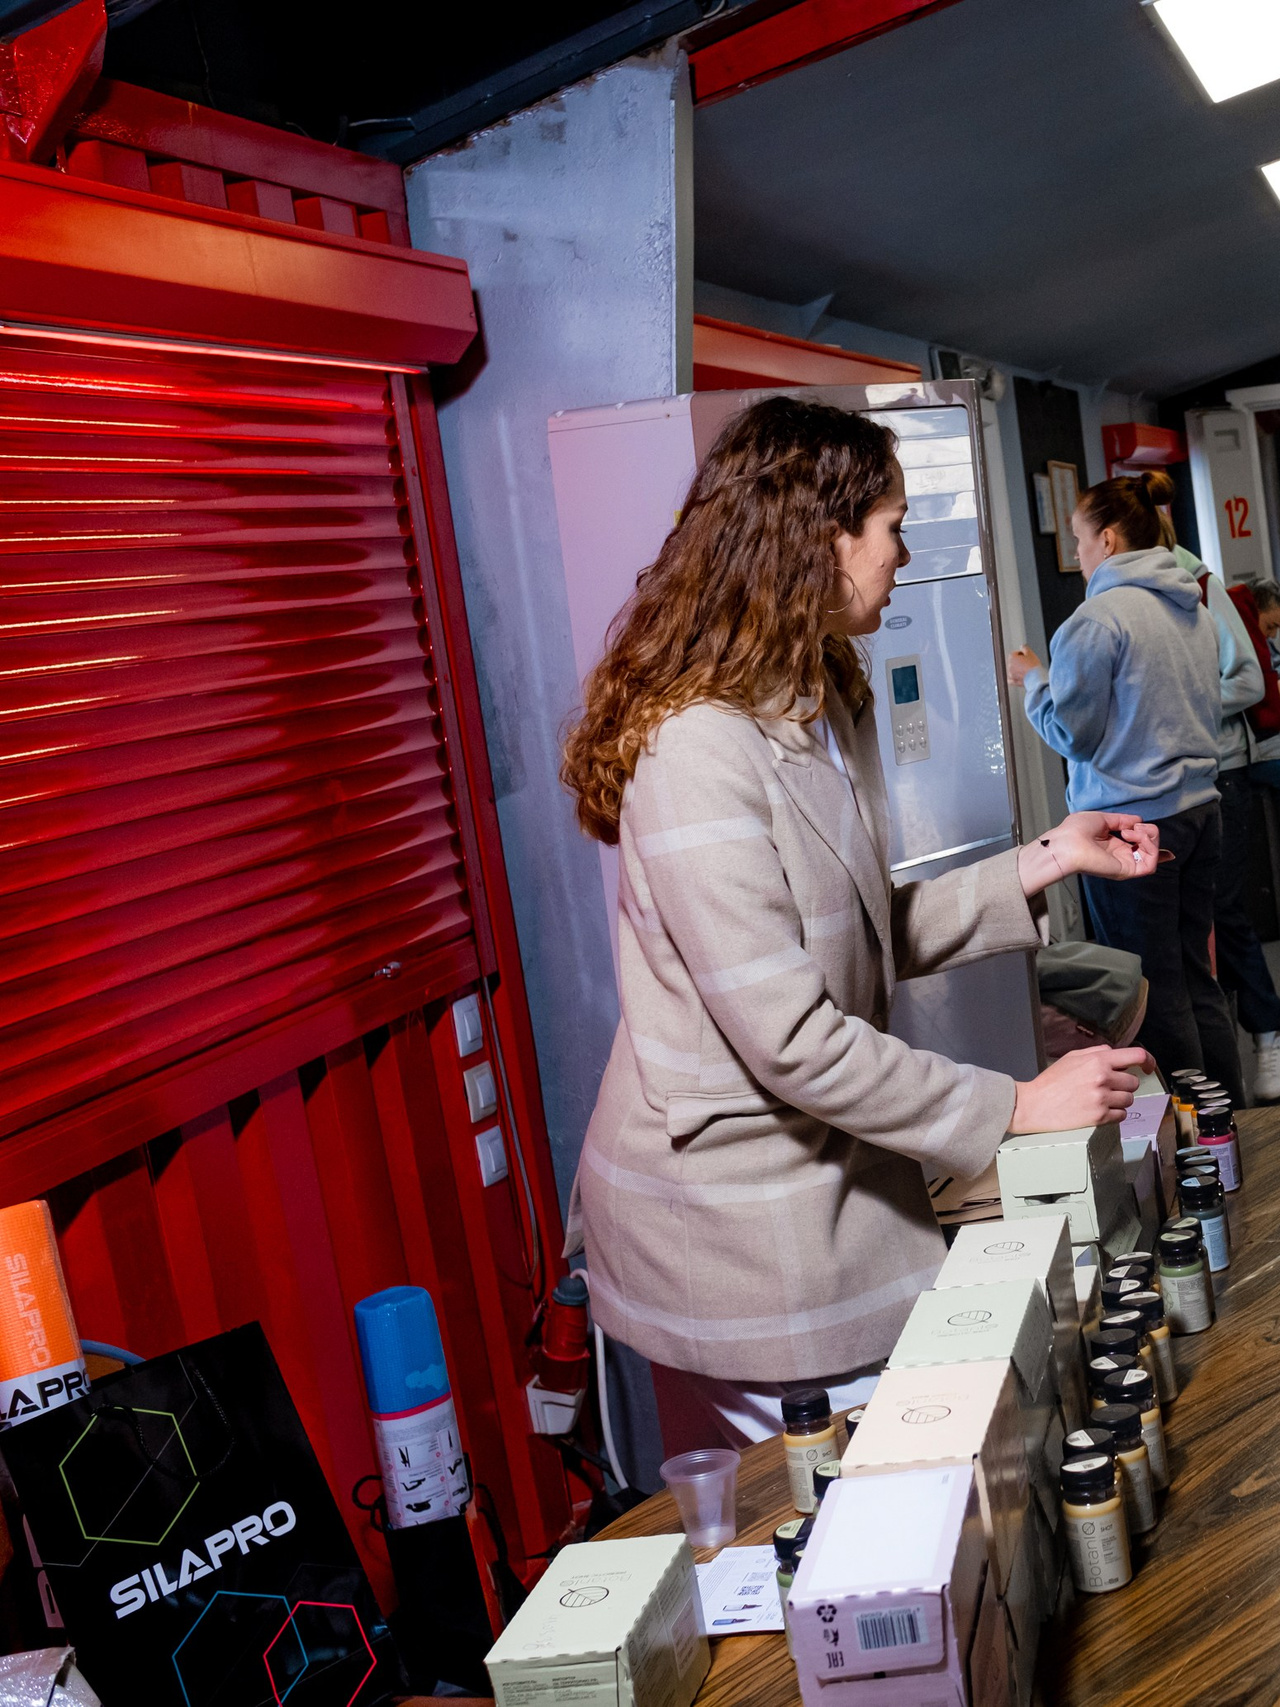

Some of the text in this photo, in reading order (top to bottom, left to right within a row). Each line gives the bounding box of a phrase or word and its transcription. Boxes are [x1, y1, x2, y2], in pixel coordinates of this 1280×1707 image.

[1225, 496, 1252, 539] 12
[4, 1252, 52, 1368] SILAPRO
[0, 1370, 92, 1421] APR
[108, 1500, 298, 1620] SILAPRO
[825, 1650, 845, 1669] EAC
